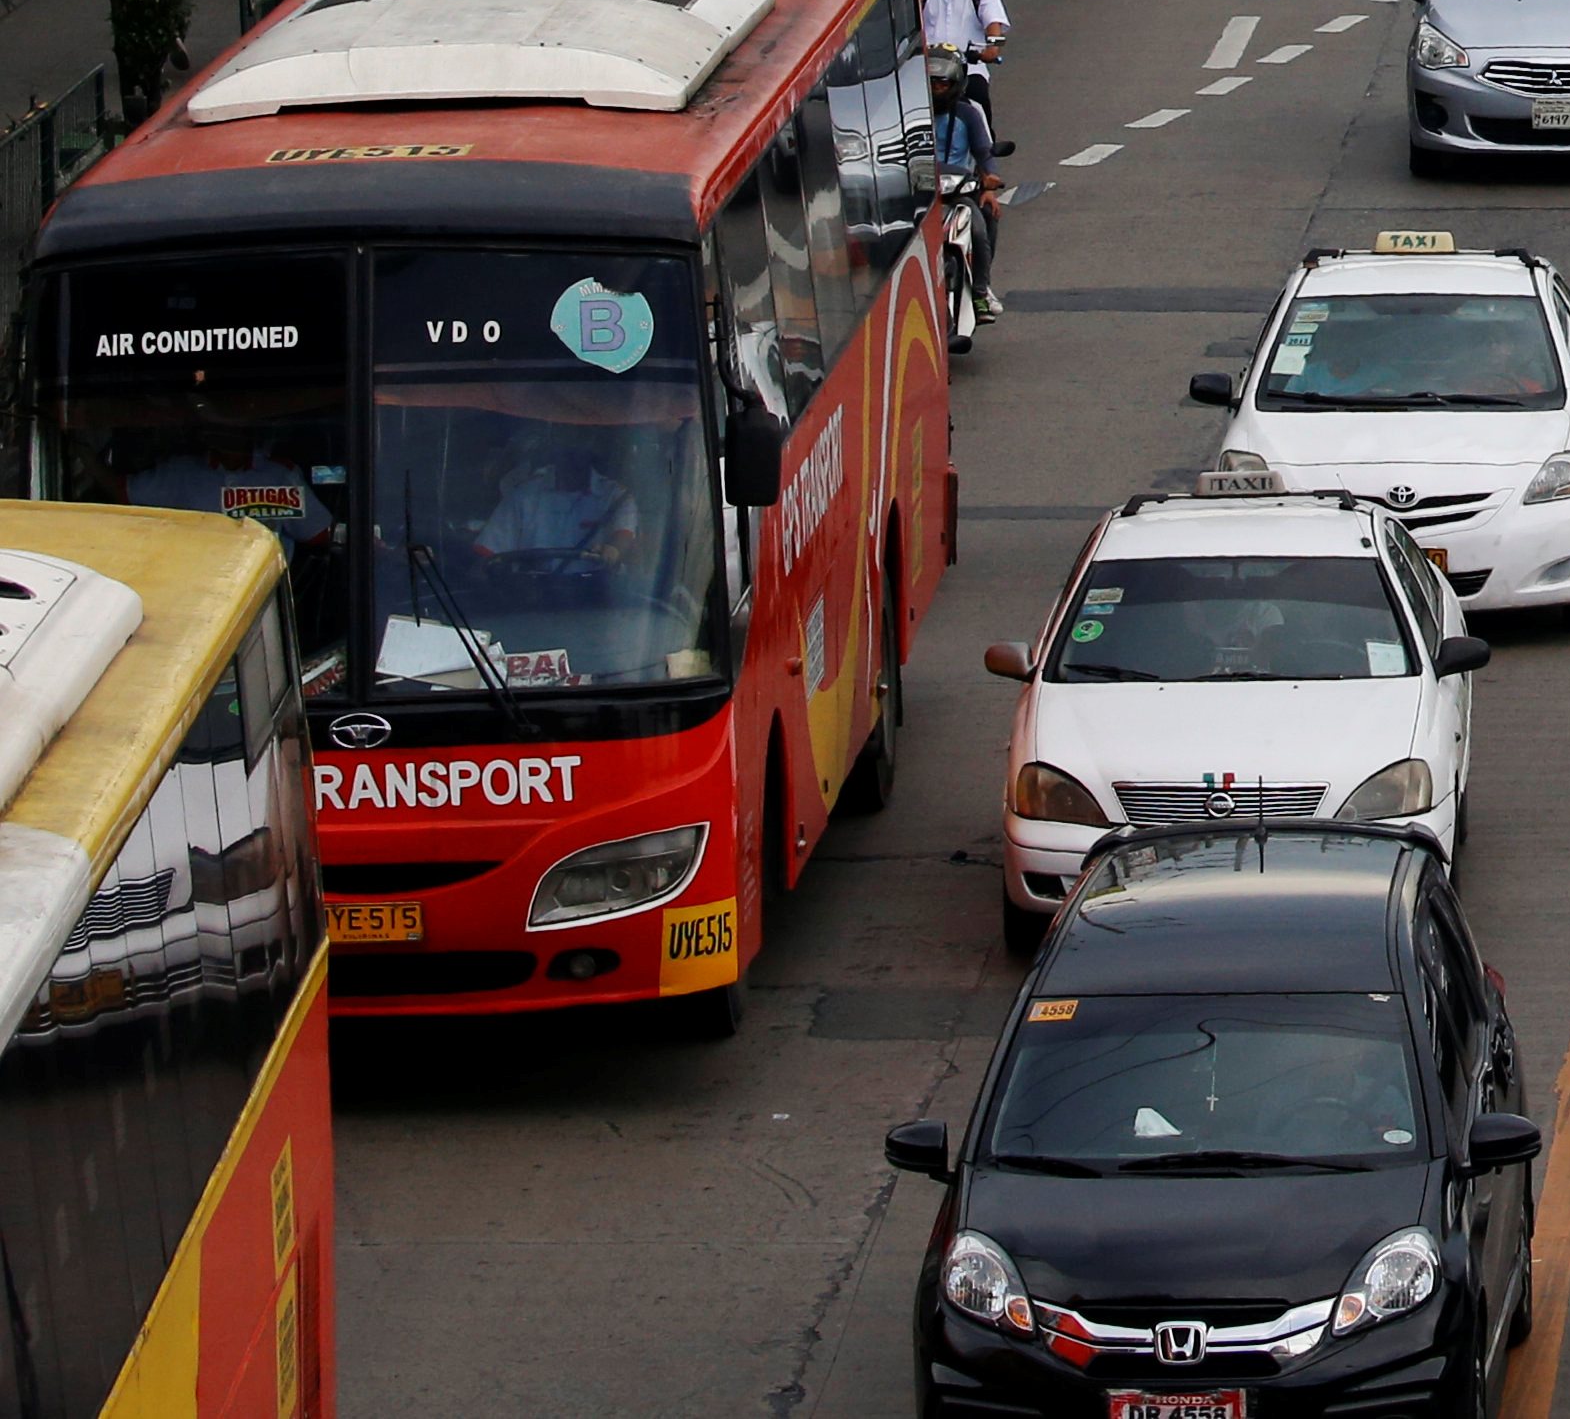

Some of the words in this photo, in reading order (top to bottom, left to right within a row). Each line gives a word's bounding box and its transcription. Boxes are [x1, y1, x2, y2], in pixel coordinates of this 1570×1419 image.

[270, 143, 466, 162] UYE515
[1388, 233, 1438, 251] TAXI
[579, 300, 625, 352] B
[96, 334, 135, 356] AIR
[141, 326, 299, 354] CONDITIONED
[1213, 476, 1270, 490] TAXI
[224, 487, 300, 509] ORTIGAS
[314, 755, 582, 810] RANSPORT
[1040, 1002, 1075, 1015] 4558
[1154, 1395, 1216, 1405] HONDA
